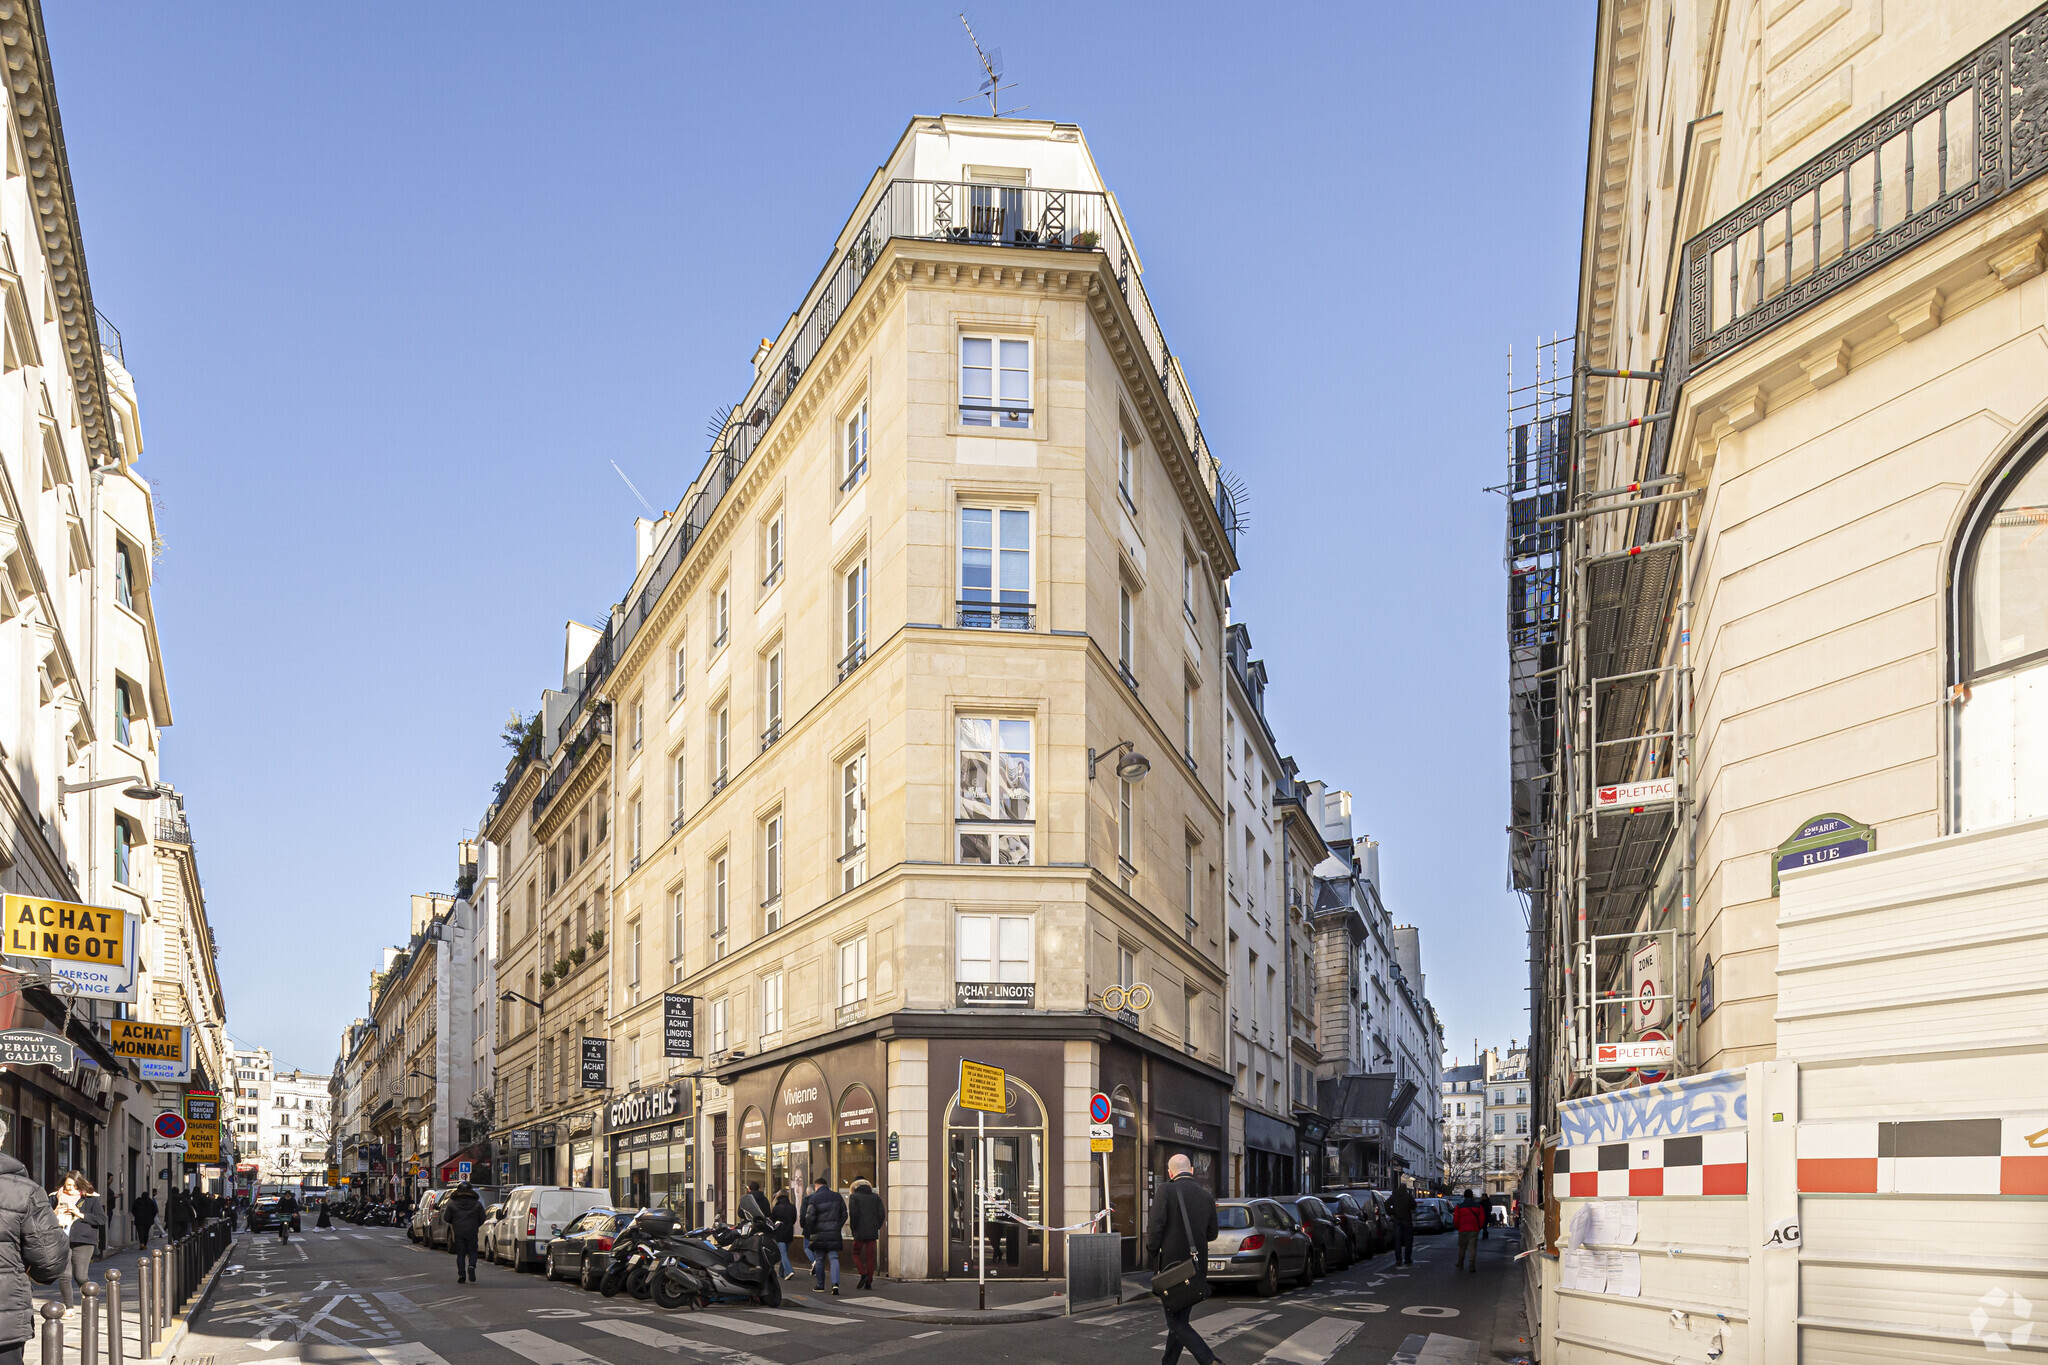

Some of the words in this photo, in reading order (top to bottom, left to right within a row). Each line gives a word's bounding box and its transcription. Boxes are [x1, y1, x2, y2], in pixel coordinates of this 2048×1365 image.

[1619, 783, 1671, 798] PLETTAC
[1803, 847, 1840, 865] RUE
[18, 904, 111, 933] ACHAT
[13, 929, 118, 959] LINGOT
[1639, 954, 1653, 971] ZONE
[58, 969, 108, 982] MERSON
[958, 985, 989, 997] ACHAT
[994, 986, 1035, 997] LINGOTS
[1642, 990, 1652, 1005] 30
[122, 1025, 172, 1041] ACHAT
[666, 1029, 692, 1038] LINGOTS
[113, 1040, 179, 1058] MONNAIE
[668, 1039, 690, 1047] PIECES
[5, 1052, 62, 1063] GALLAIS
[1618, 1047, 1671, 1058] PLETTAC
[143, 1070, 174, 1078] CHANGE
[589, 1072, 599, 1080] OR
[783, 1087, 818, 1106] Vivienne
[611, 1097, 645, 1127] GODOT
[645, 1101, 651, 1119] &
[652, 1088, 675, 1118] FILS
[188, 1122, 217, 1130] CHANGE
[787, 1111, 813, 1129] Optique
[1173, 1122, 1190, 1136] Vivienne
[1190, 1127, 1204, 1142] Optique
